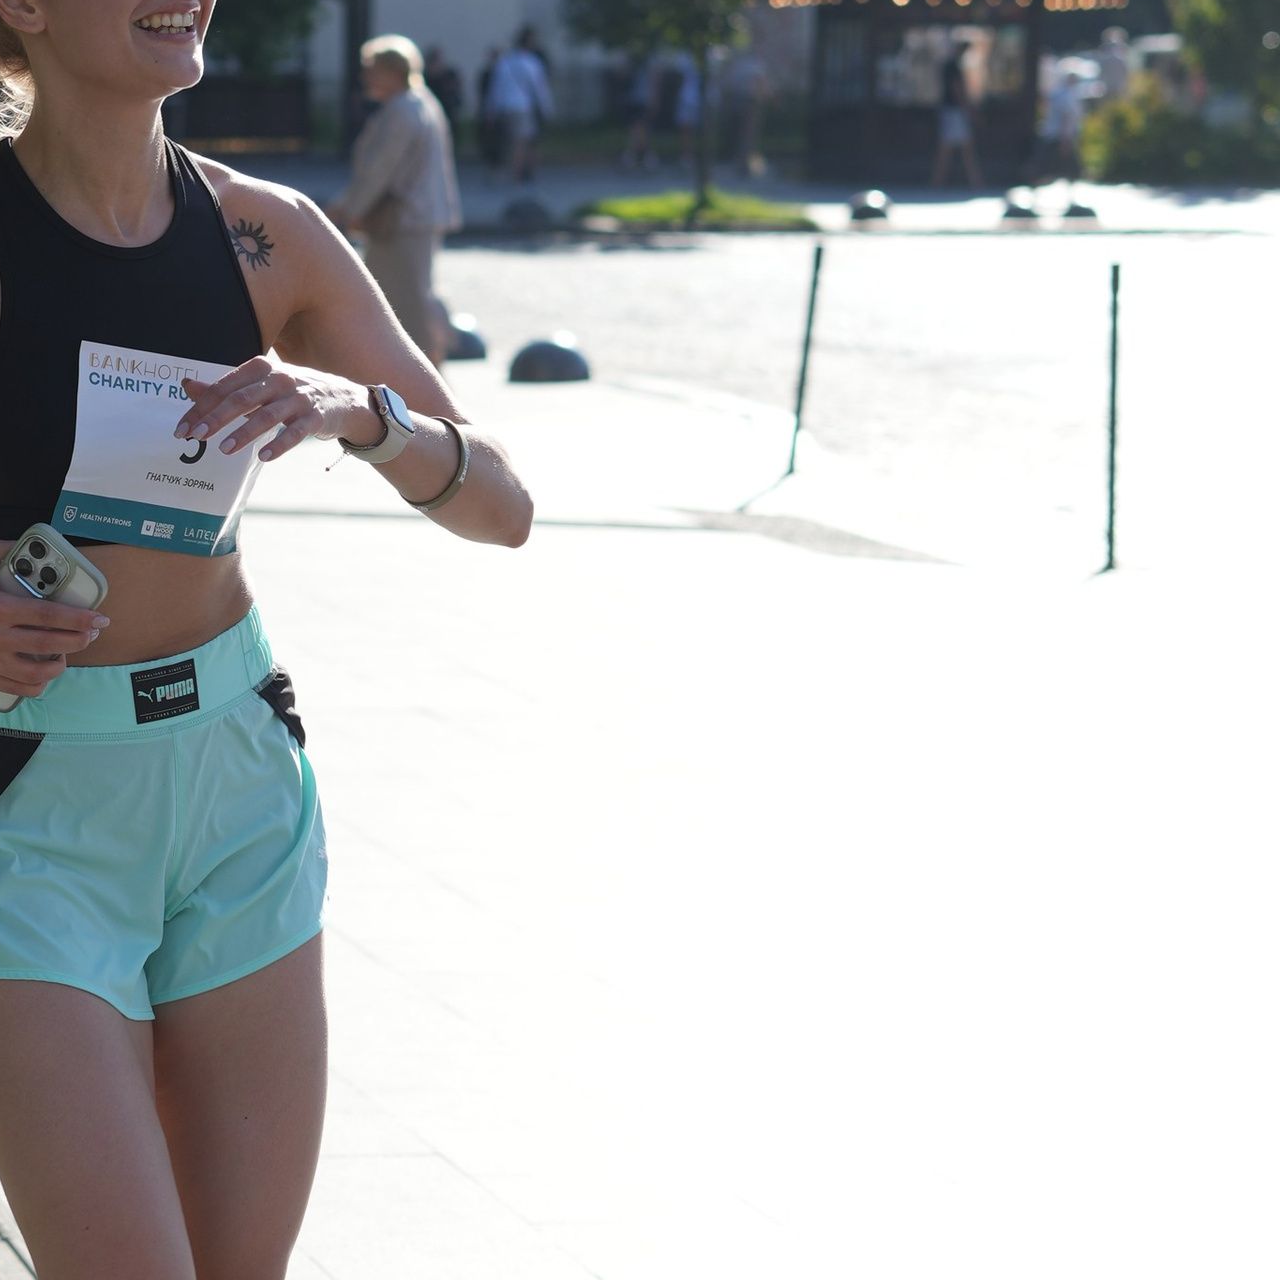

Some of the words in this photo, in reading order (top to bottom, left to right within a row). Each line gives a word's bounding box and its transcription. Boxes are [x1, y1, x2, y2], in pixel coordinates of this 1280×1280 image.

[88, 372, 164, 396] CHARITY
[168, 385, 195, 402] RU
[145, 471, 182, 485] ГНАТЧУК
[182, 477, 215, 491] ЗОРЯНА
[80, 512, 103, 523] HEALTH
[102, 516, 132, 527] PATRONS
[156, 678, 195, 702] PUMA
